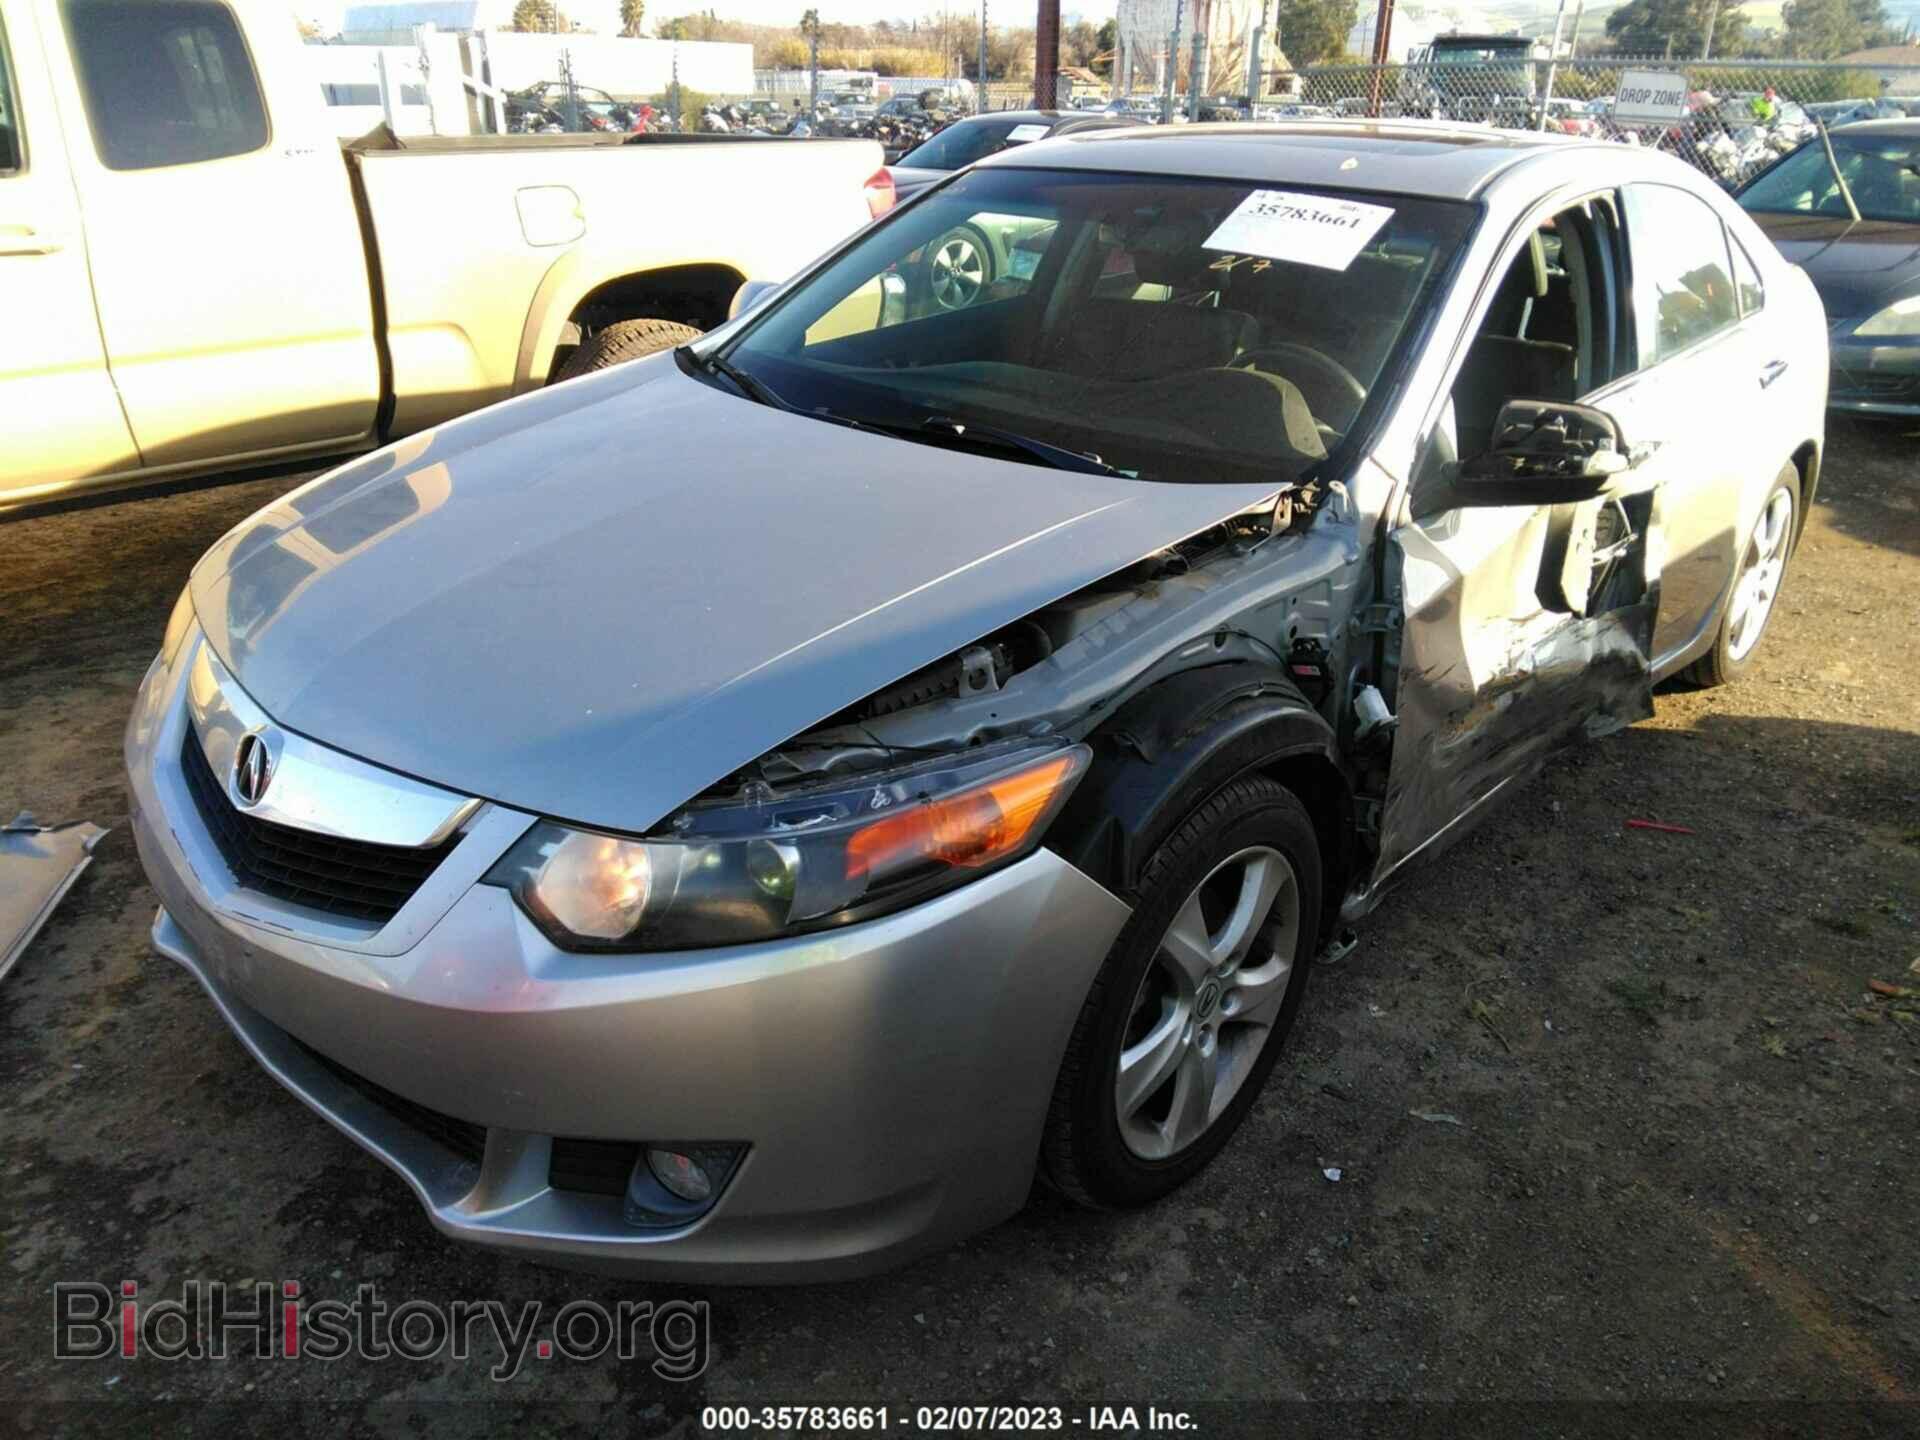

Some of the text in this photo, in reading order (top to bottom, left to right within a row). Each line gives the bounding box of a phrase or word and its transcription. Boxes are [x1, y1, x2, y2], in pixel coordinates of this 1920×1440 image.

[1620, 87, 1683, 106] DROP ZONE
[1248, 203, 1361, 229] 35783661
